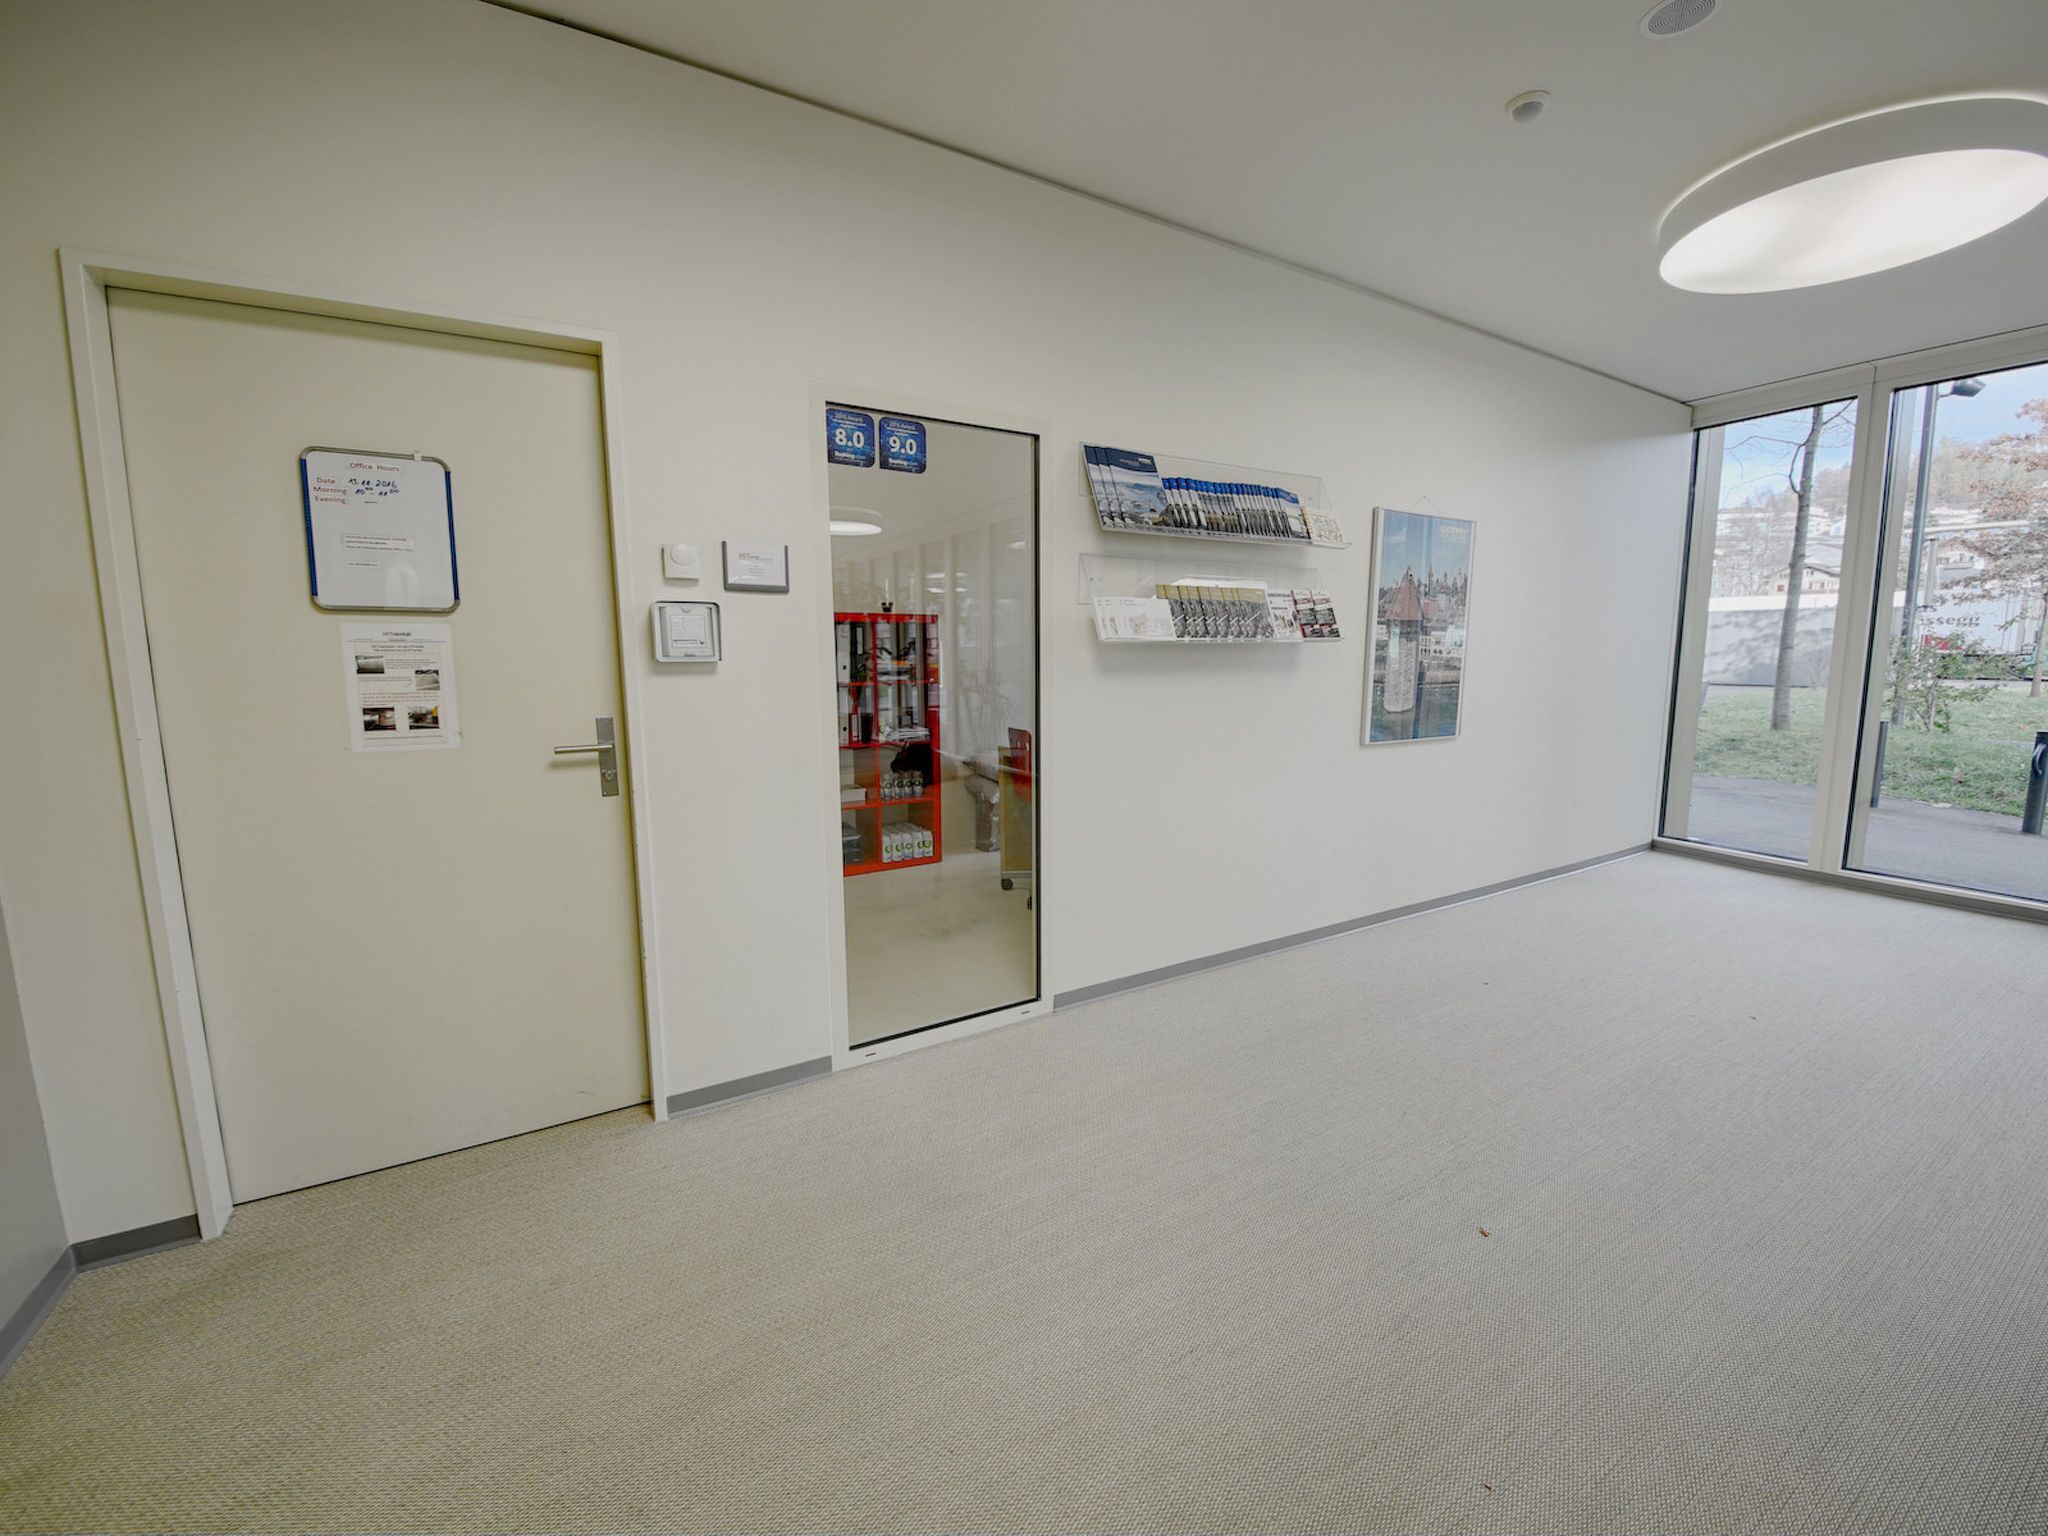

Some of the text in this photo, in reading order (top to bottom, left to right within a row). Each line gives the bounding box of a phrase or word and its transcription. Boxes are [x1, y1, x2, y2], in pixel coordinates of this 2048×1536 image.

[835, 428, 865, 448] 8.0
[889, 436, 917, 455] 9.0
[349, 462, 400, 472] Office Hours
[316, 476, 336, 484] Date
[313, 486, 347, 496] Morning
